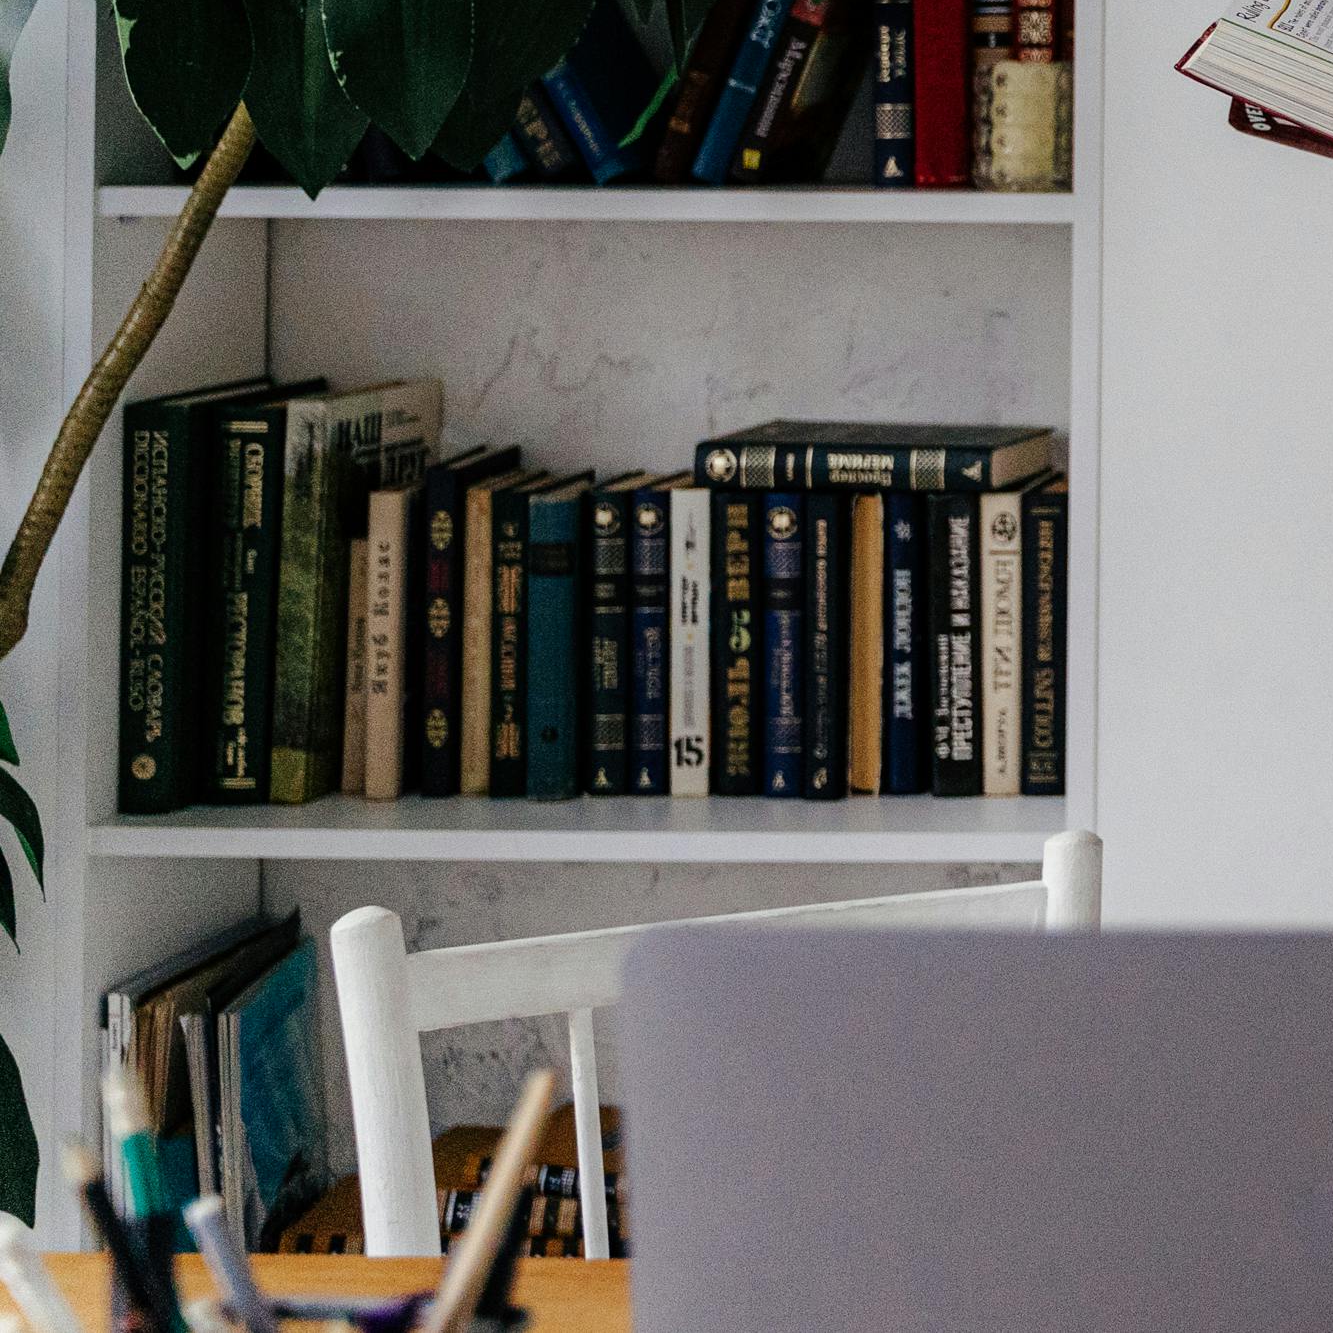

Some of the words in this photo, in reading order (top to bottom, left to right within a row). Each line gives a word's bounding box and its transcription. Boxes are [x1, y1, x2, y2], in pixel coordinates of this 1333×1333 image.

[131, 430, 149, 554] DICCIONARIO
[370, 540, 391, 617] Колас
[726, 504, 749, 599] ВЕРН
[949, 516, 969, 608] НАКАЗАНИЕ
[893, 569, 911, 652] ЛОНДОН
[951, 613, 970, 626] И
[145, 653, 163, 742] СЛОВАРЬ
[893, 661, 912, 718] ДЖЕК
[951, 632, 972, 760] ПРЕСТУПЛЕНИЕ
[992, 645, 1011, 691] ТРИ
[1034, 668, 1052, 747] COLLINS
[673, 736, 703, 767] 15
[726, 657, 749, 774] ЖЮЛЬ
